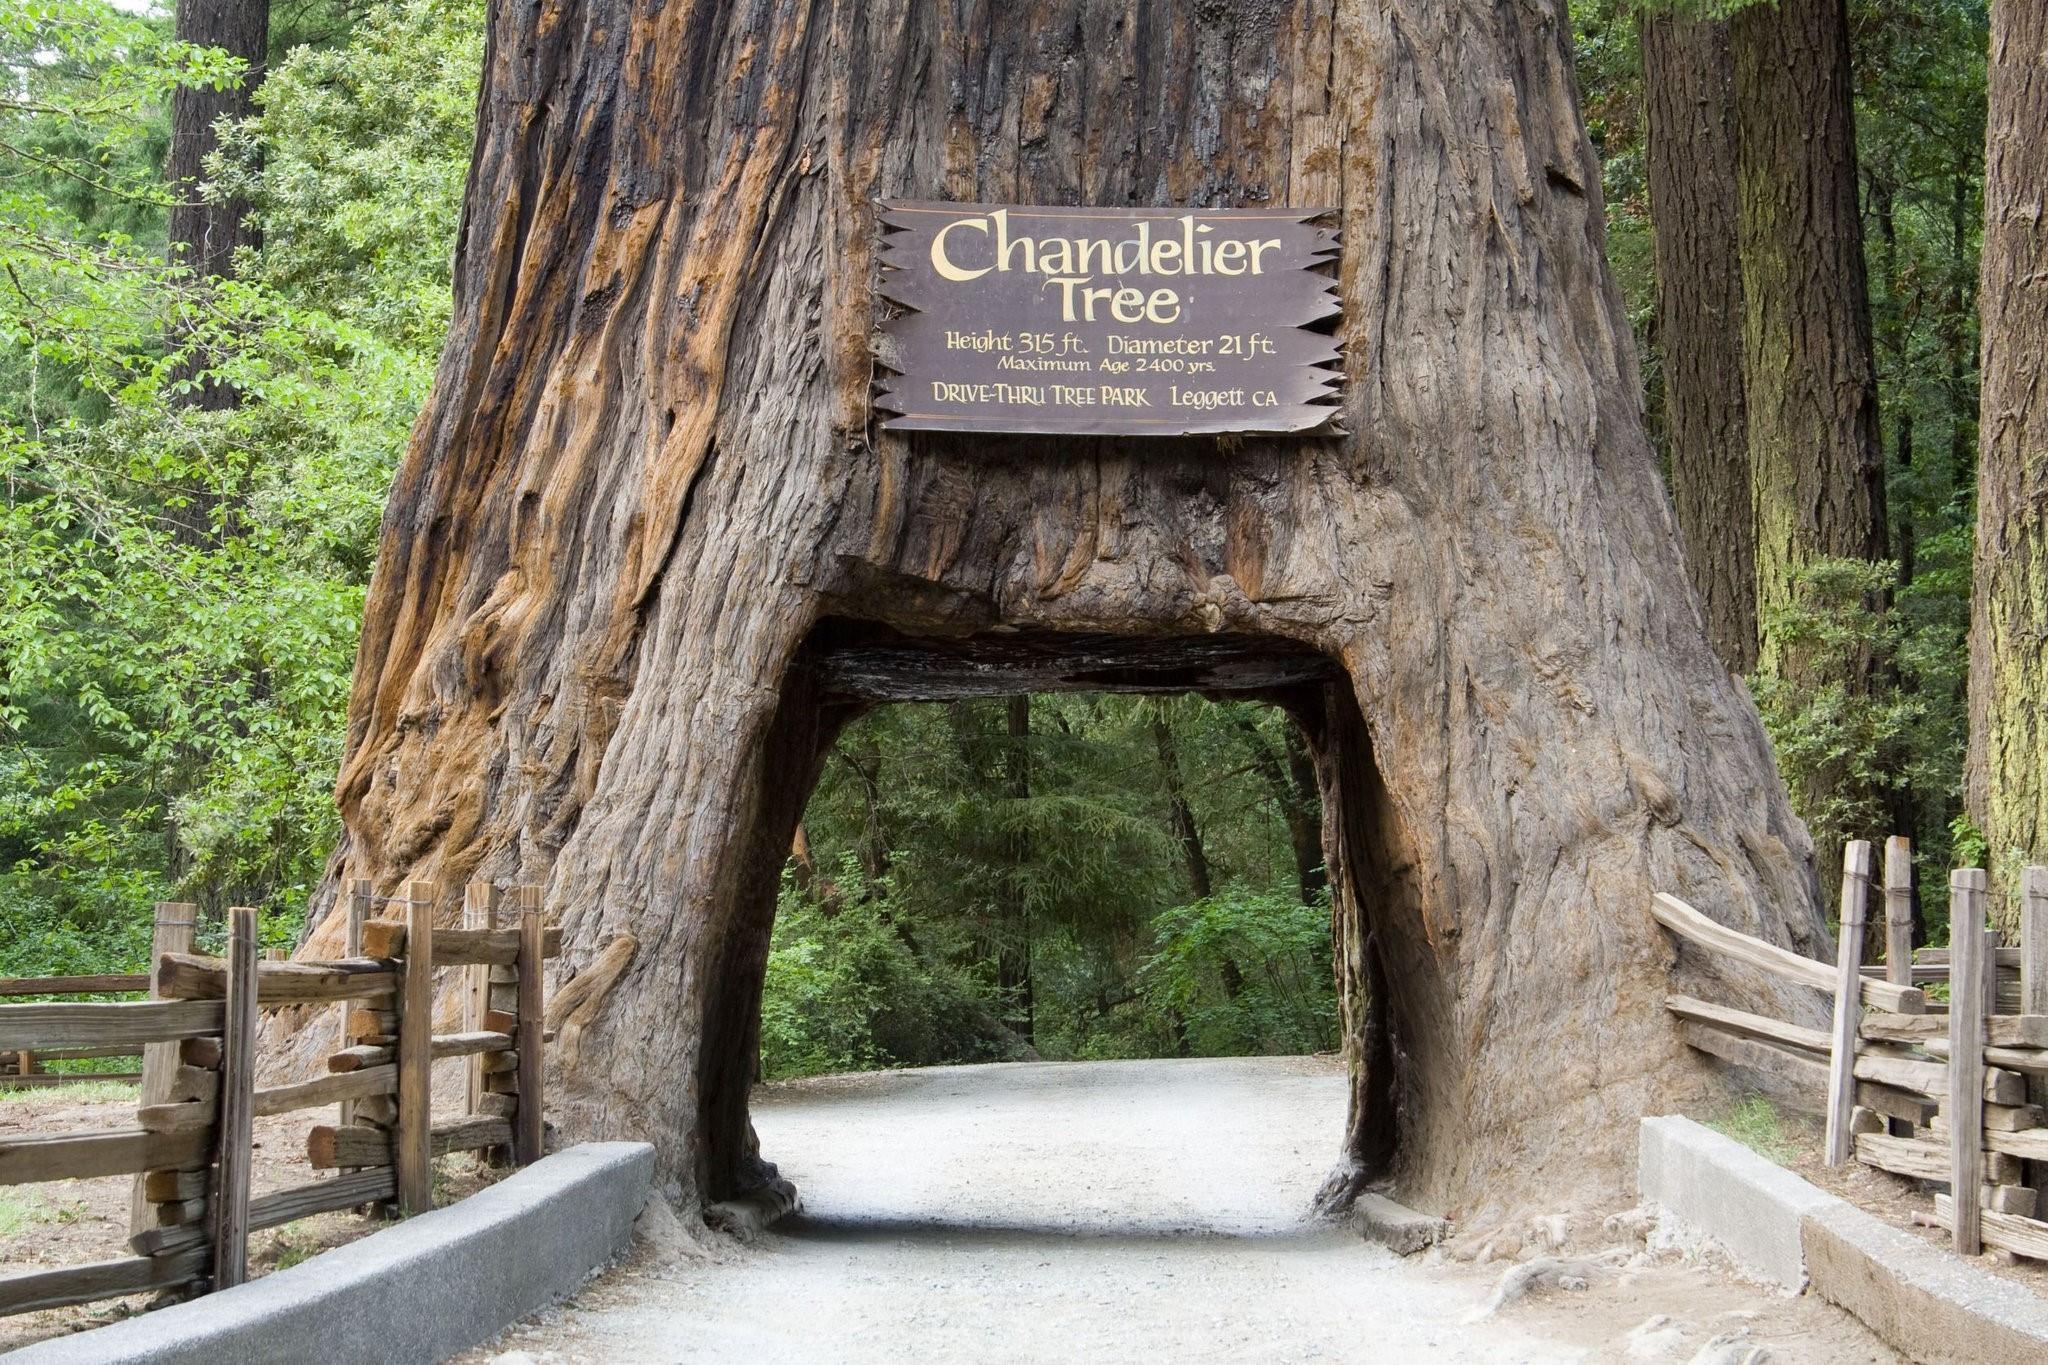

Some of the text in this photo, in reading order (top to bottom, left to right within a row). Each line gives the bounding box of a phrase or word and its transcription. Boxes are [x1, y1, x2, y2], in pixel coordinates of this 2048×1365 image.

[931, 208, 1280, 281] Chandelier
[1042, 277, 1181, 324] Tree
[945, 330, 1276, 360] Height 315 ft. Diameter 21 ft.
[998, 356, 1215, 374] Maximum Age 2400 yrs.
[931, 382, 1278, 409] DRIVE-THRU TREE PARK Leggett CA
